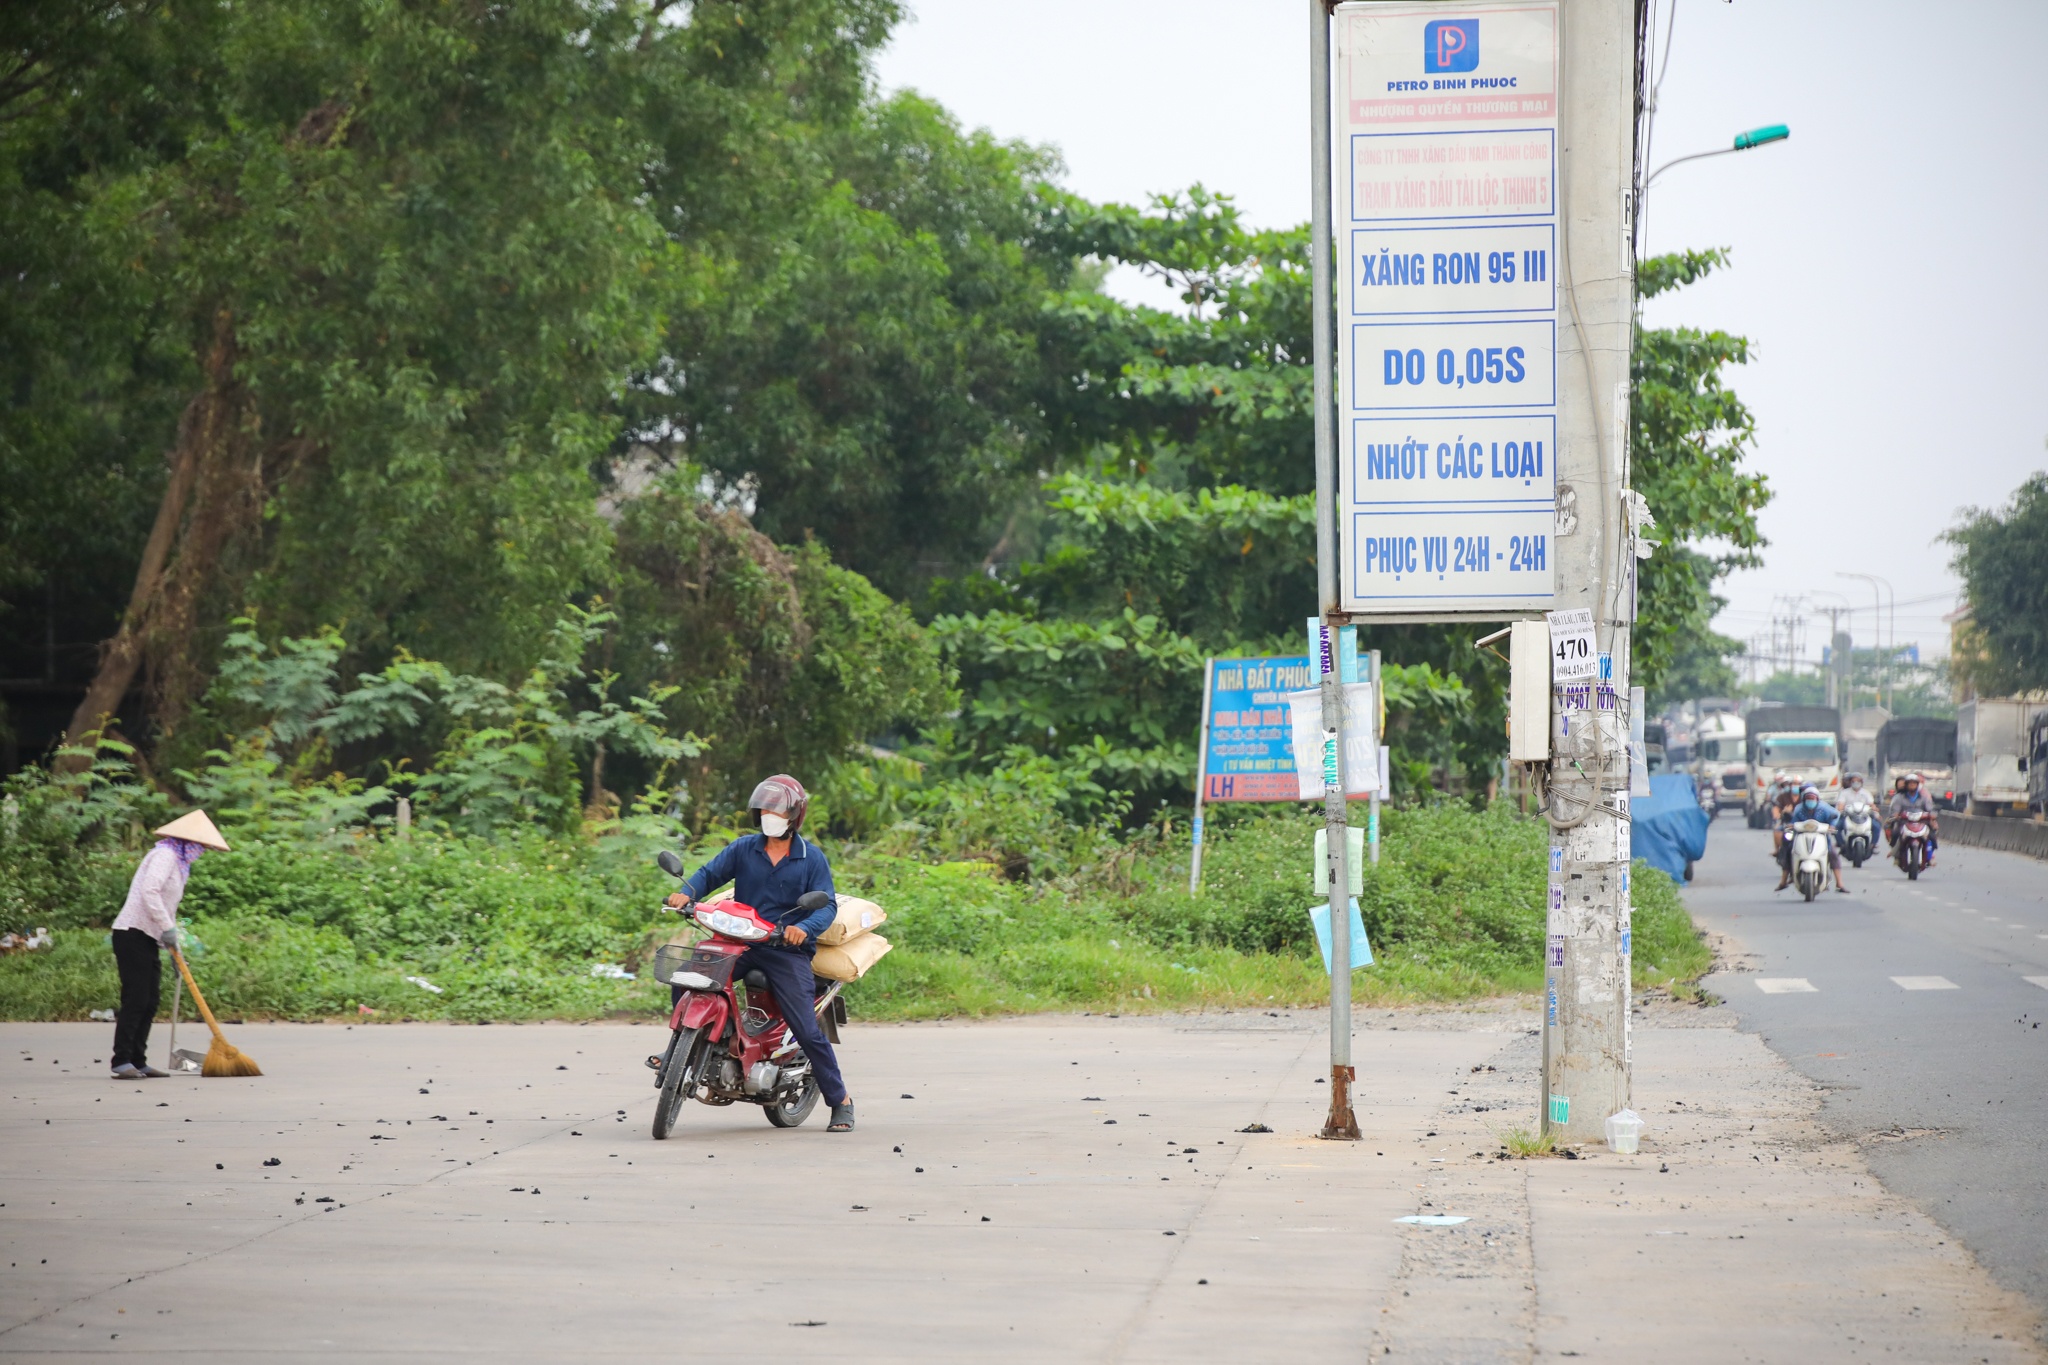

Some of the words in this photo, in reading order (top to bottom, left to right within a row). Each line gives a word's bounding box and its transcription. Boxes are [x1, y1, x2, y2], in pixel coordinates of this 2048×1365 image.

[1387, 80, 1429, 92] PETRO
[1433, 79, 1467, 90] BINH
[1471, 77, 1517, 89] PHUOC
[1359, 103, 1415, 119] NHƯỢNG
[1465, 100, 1518, 114] THƯƠNG
[1522, 100, 1548, 114] MẠI
[1385, 149, 1394, 164] TY
[1397, 148, 1419, 164] TNHH
[1469, 146, 1489, 161] NAM
[1523, 141, 1548, 160] CÔNG
[1359, 181, 1391, 215] TRẠM
[1395, 175, 1426, 208] XĂNG
[1456, 173, 1474, 207] TÀI
[1477, 172, 1499, 212] LỘC
[1502, 176, 1537, 211] THỊNH
[1540, 176, 1547, 204] 5
[1361, 248, 1424, 286] XĂNG
[1433, 252, 1480, 285] RON
[1488, 252, 1515, 284] 95
[1523, 250, 1546, 282] III
[1384, 349, 1425, 385] DO
[1437, 346, 1525, 389] 0,05S
[1367, 436, 1428, 480] NHỚT
[1437, 435, 1483, 479] CÁC
[1491, 441, 1543, 486] LOẠI
[1366, 536, 1416, 581] PHỤC
[1423, 537, 1447, 580] VỤ
[1454, 536, 1489, 572] 24H
[1510, 535, 1545, 571] 24H
[1556, 638, 1588, 660] 470
[1217, 664, 1244, 690] NHÀ
[1247, 660, 1273, 689] ĐẤT
[1276, 660, 1311, 688] PHÚC
[1214, 711, 1239, 727] MUA
[1241, 706, 1261, 726] BÁN
[1211, 776, 1234, 797] LH
